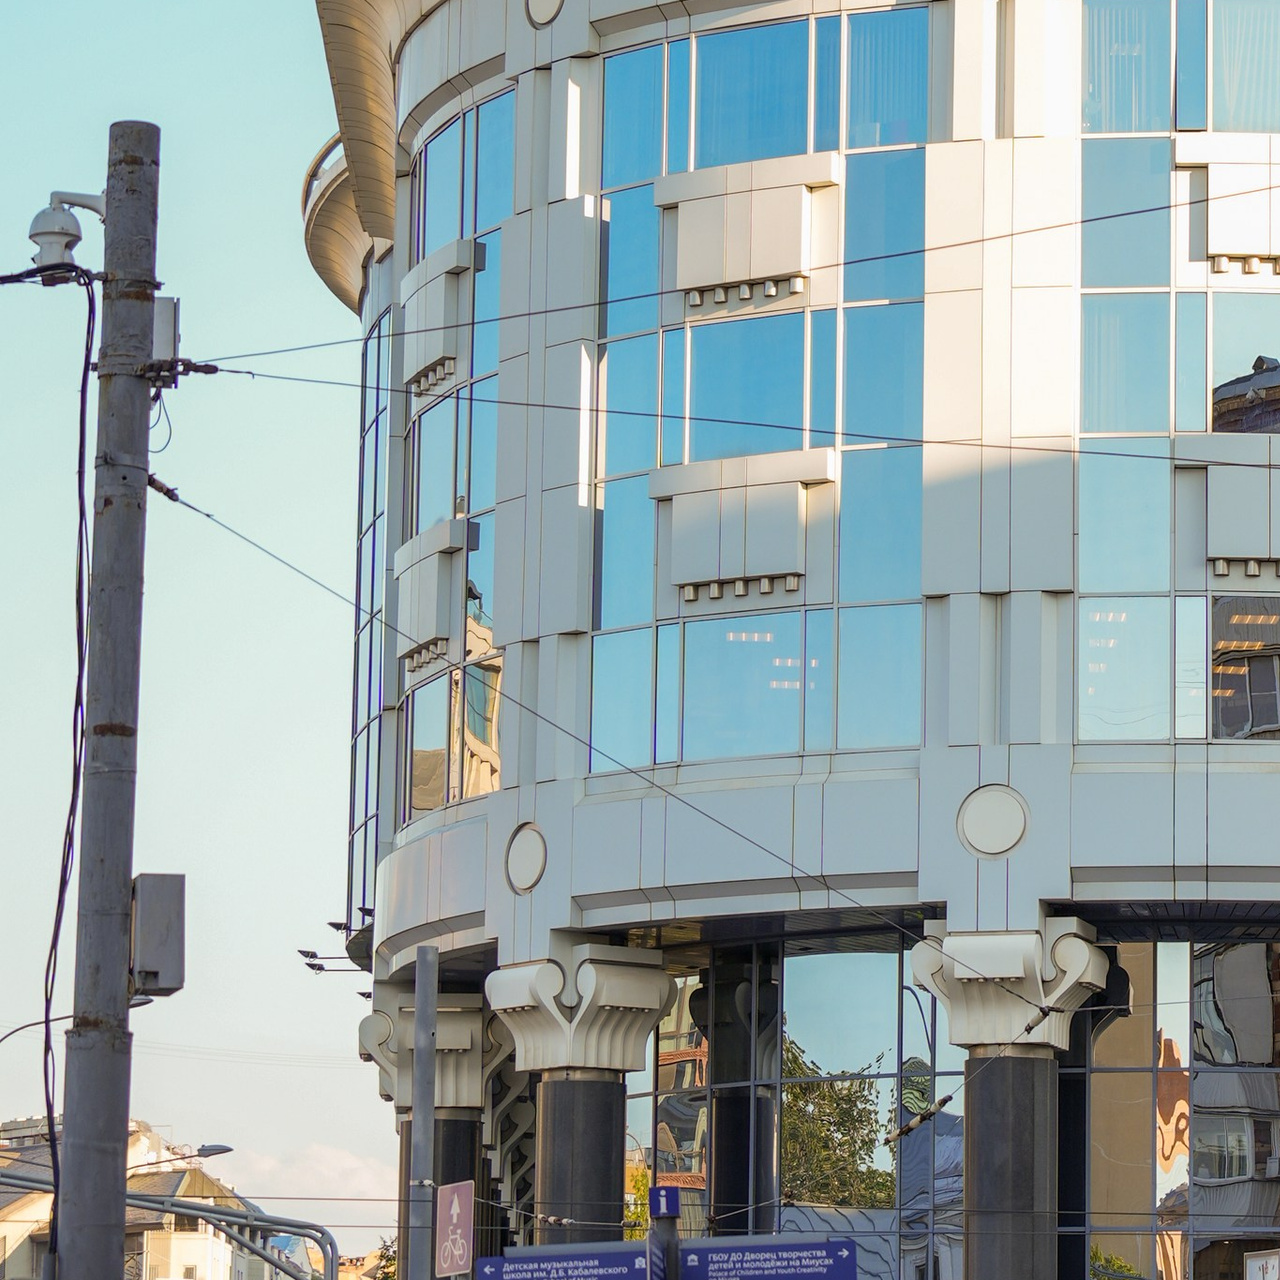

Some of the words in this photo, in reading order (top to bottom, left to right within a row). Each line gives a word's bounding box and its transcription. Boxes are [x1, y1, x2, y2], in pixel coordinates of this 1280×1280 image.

[708, 1253, 729, 1261] ГБОУ
[730, 1252, 743, 1262] ДО
[744, 1251, 777, 1261] Дворец
[778, 1250, 827, 1259] творчества
[503, 1263, 539, 1272] Детская
[540, 1260, 599, 1270] музыкальная
[708, 1262, 734, 1271] детей
[742, 1259, 788, 1269] молодёжи
[801, 1258, 834, 1267] Миусах
[777, 1267, 796, 1275] Youth
[796, 1266, 827, 1274] Creativity
[503, 1271, 532, 1280] школа
[568, 1266, 628, 1276] Кабалевского
